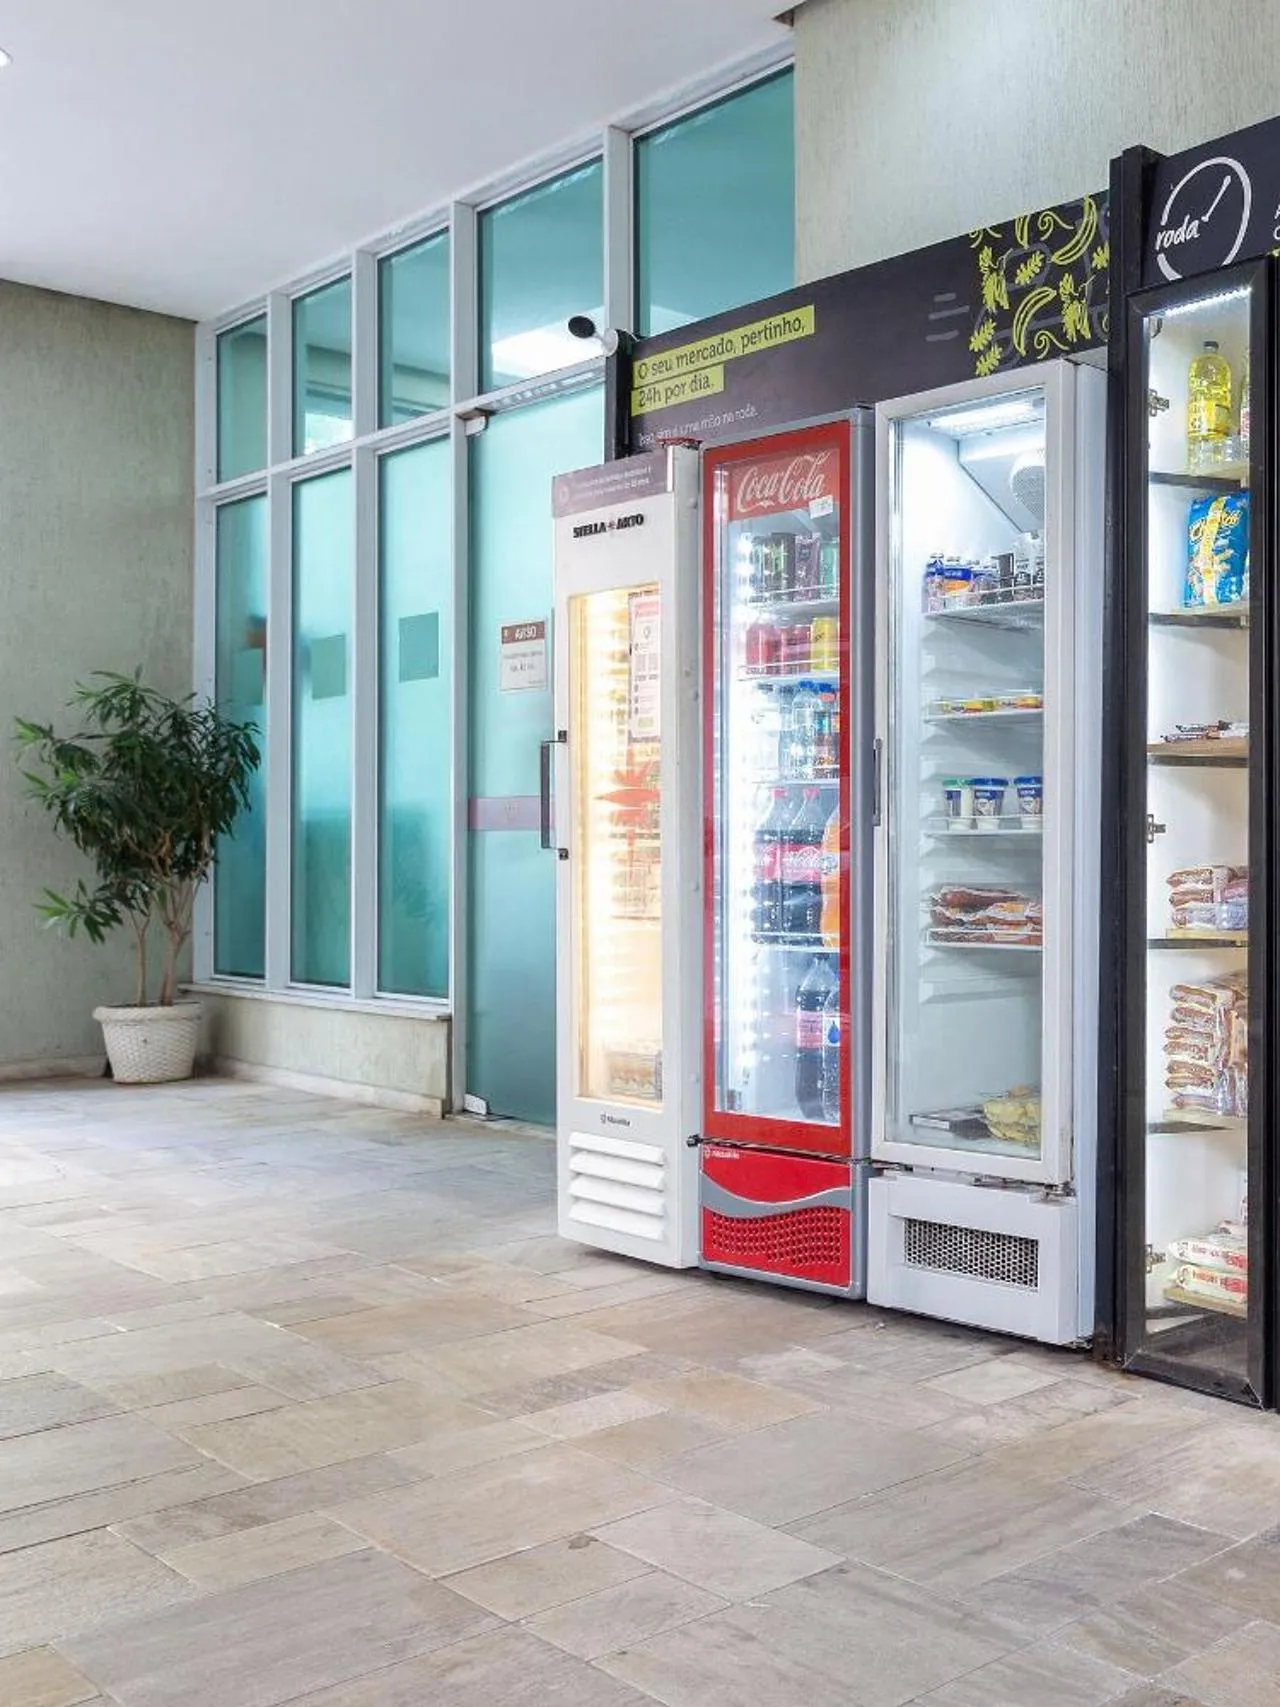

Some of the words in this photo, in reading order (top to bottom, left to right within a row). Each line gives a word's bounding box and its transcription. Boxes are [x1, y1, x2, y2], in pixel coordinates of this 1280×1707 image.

[1155, 214, 1201, 250] roda
[638, 362, 649, 380] O
[652, 359, 673, 377] seu
[676, 337, 737, 369] mercado,
[740, 316, 806, 354] pertinho,
[638, 386, 662, 408] 24h
[665, 381, 687, 404] por
[573, 522, 607, 538] STELLA
